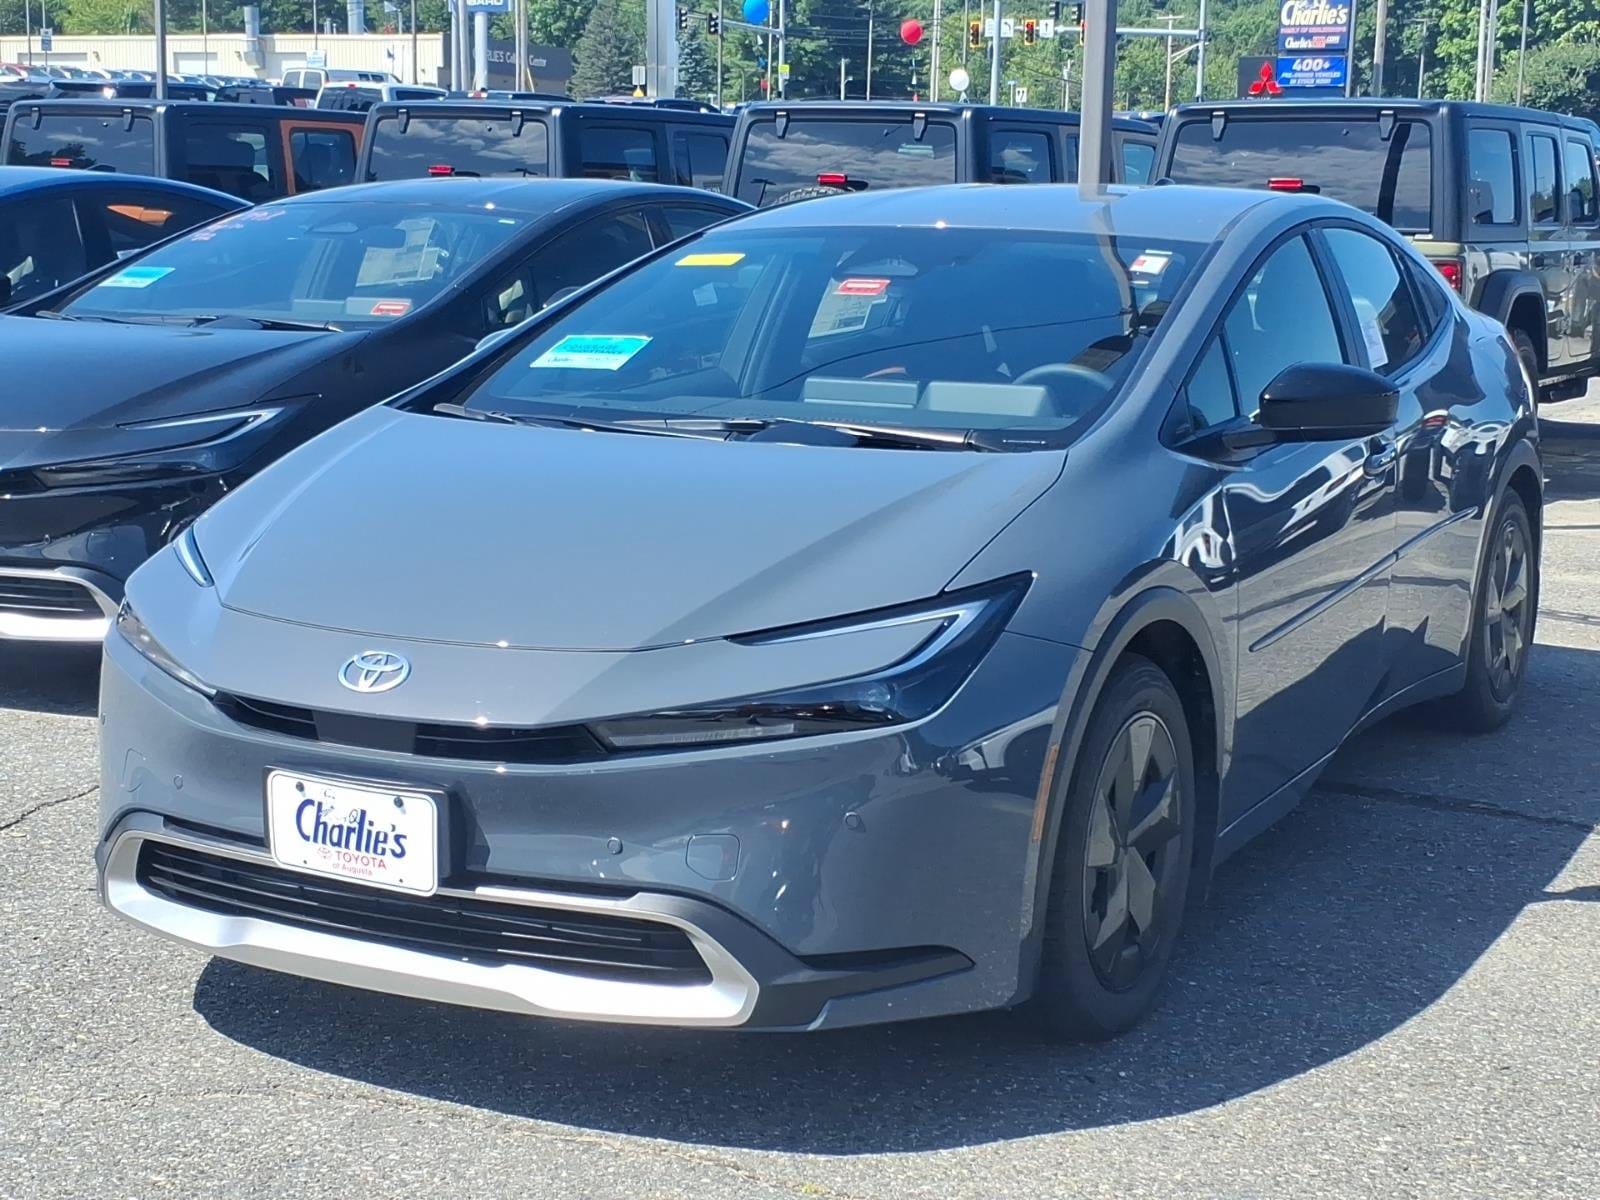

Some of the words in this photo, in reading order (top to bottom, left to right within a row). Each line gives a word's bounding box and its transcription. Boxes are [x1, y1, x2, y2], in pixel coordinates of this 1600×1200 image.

[1281, 0, 1348, 25] Charlie's
[1292, 58, 1330, 71] 400+
[295, 798, 407, 859] Charlie's
[335, 850, 387, 870] TOYOTA
[342, 864, 373, 876] Augusta
